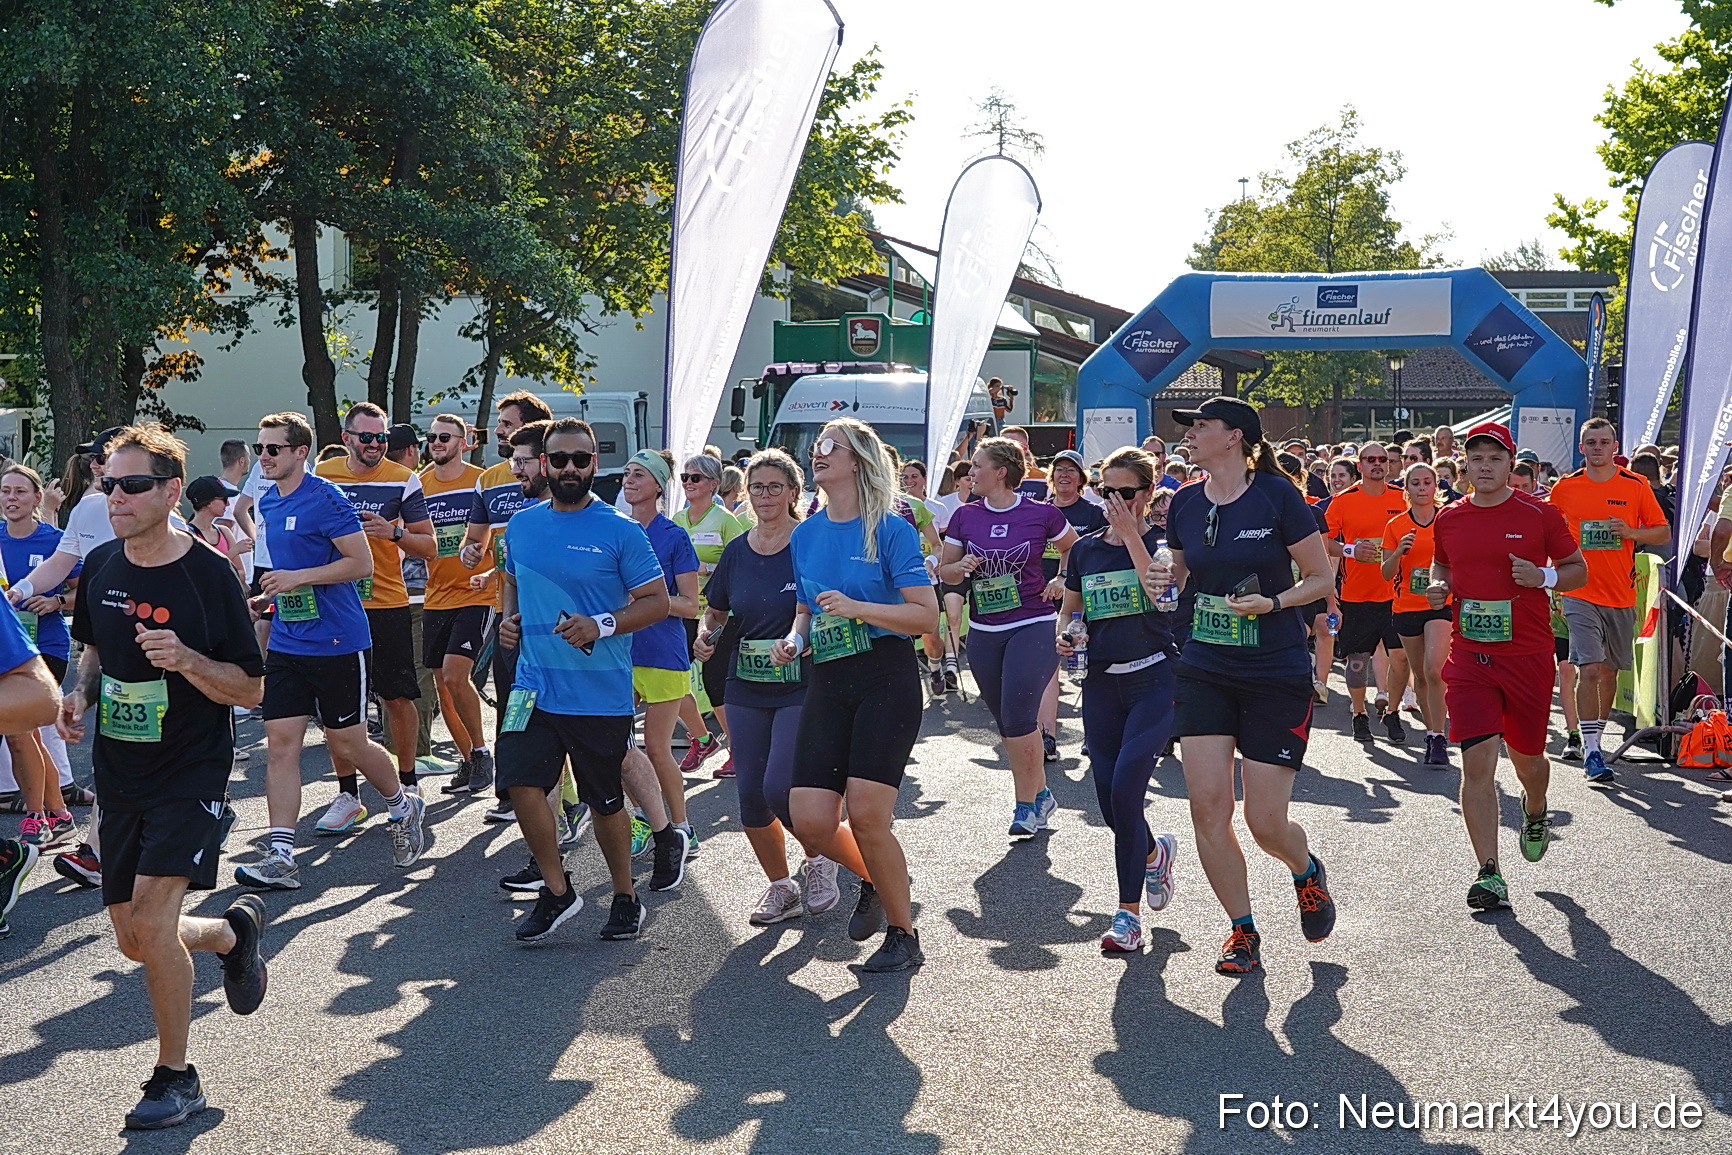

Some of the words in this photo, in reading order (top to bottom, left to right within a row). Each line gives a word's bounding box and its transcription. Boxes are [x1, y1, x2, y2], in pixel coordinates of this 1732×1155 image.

[1663, 168, 1709, 272] Fischer
[1303, 307, 1393, 325] firmenlauf
[1302, 325, 1340, 333] neumarkt
[1131, 338, 1179, 349] Fischer
[788, 400, 828, 411] abavent
[430, 507, 470, 519] Fischer
[566, 544, 592, 552] RAILONE
[281, 595, 304, 609] 968
[980, 587, 1010, 603] 1567
[1091, 585, 1130, 605] 1164
[1130, 586, 1140, 608] 2022
[1199, 609, 1231, 630] 1163
[1231, 617, 1239, 639] 2022
[1466, 613, 1502, 628] 1233
[815, 625, 844, 647] 1813
[842, 626, 852, 649] 2022
[740, 652, 774, 669] 1162
[1129, 658, 1150, 669] NIKE
[1151, 652, 1164, 661] PR
[111, 700, 148, 722] 233
[133, 723, 150, 731] Ralf
